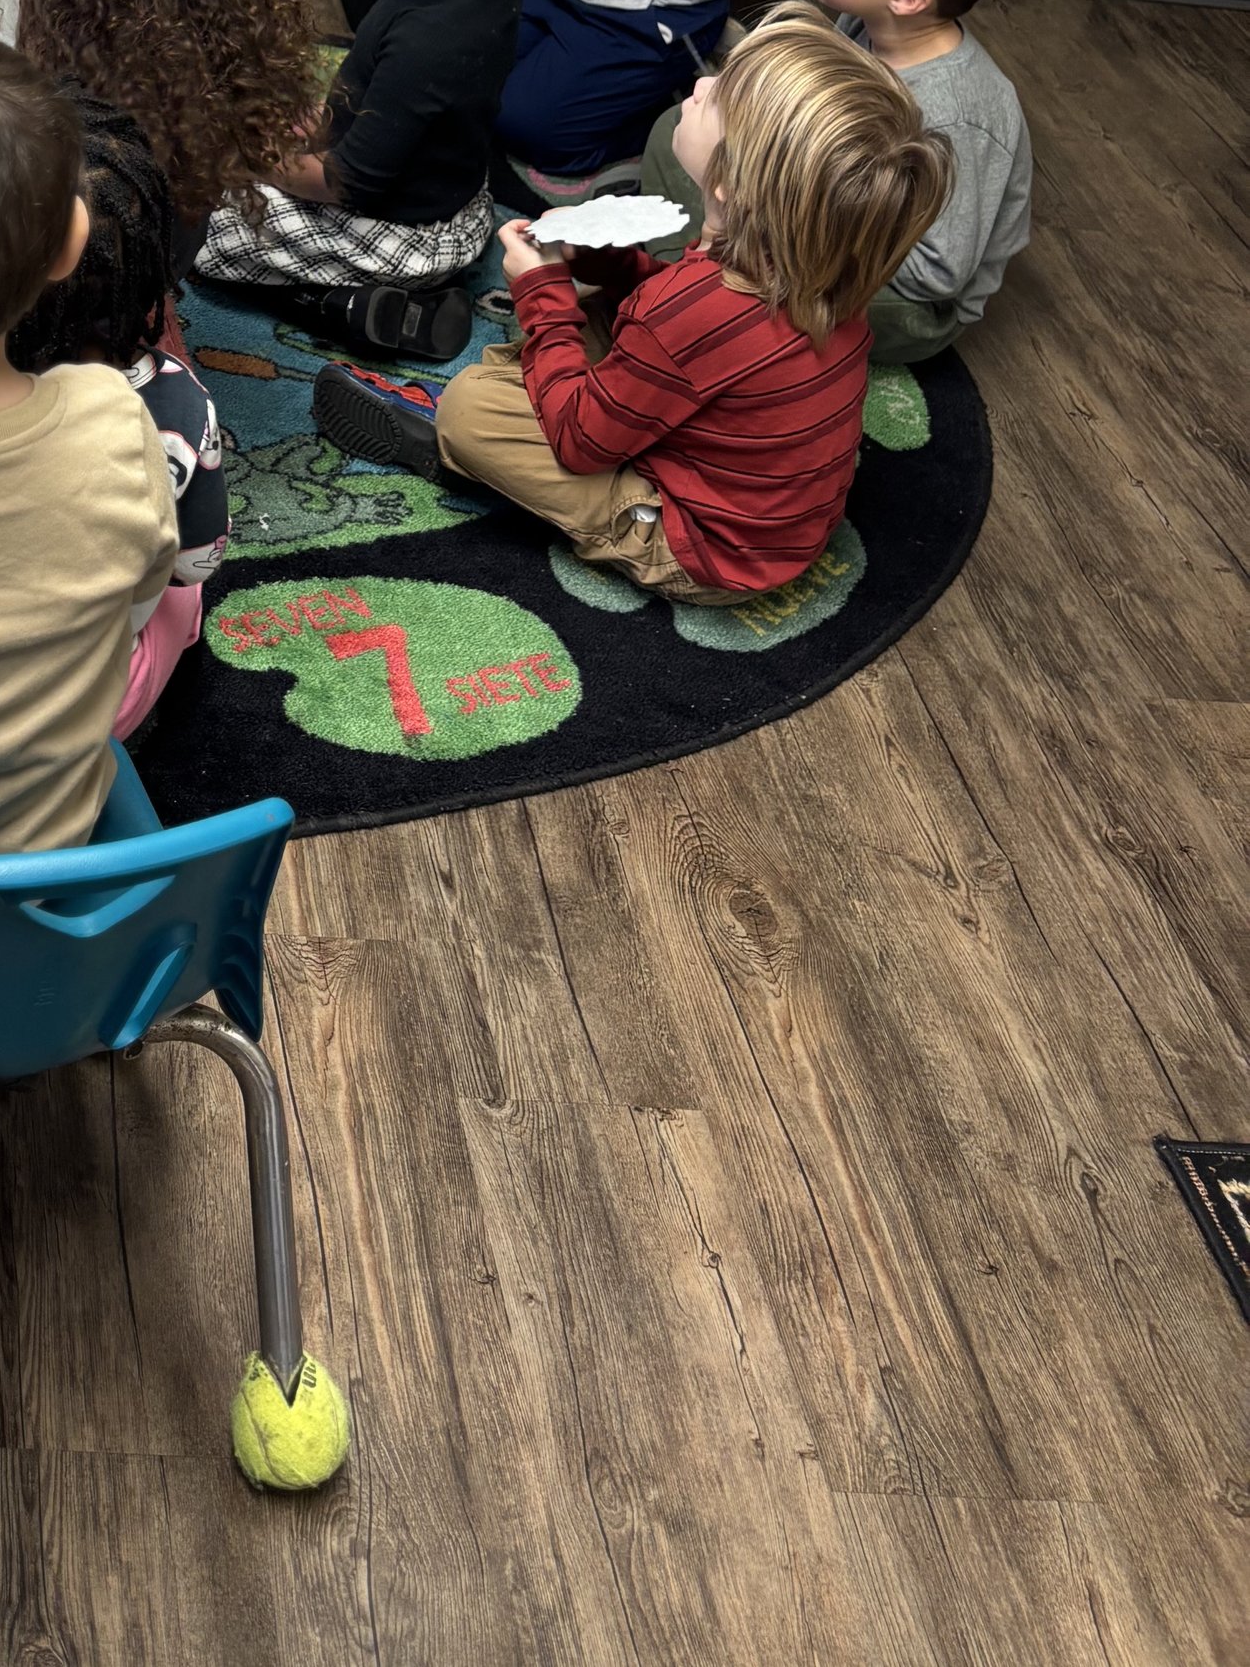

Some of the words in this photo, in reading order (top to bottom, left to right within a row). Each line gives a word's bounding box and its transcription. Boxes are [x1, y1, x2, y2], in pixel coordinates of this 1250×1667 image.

[217, 586, 371, 655] SEVEN
[325, 624, 434, 736] 7
[444, 651, 573, 716] SIETE
